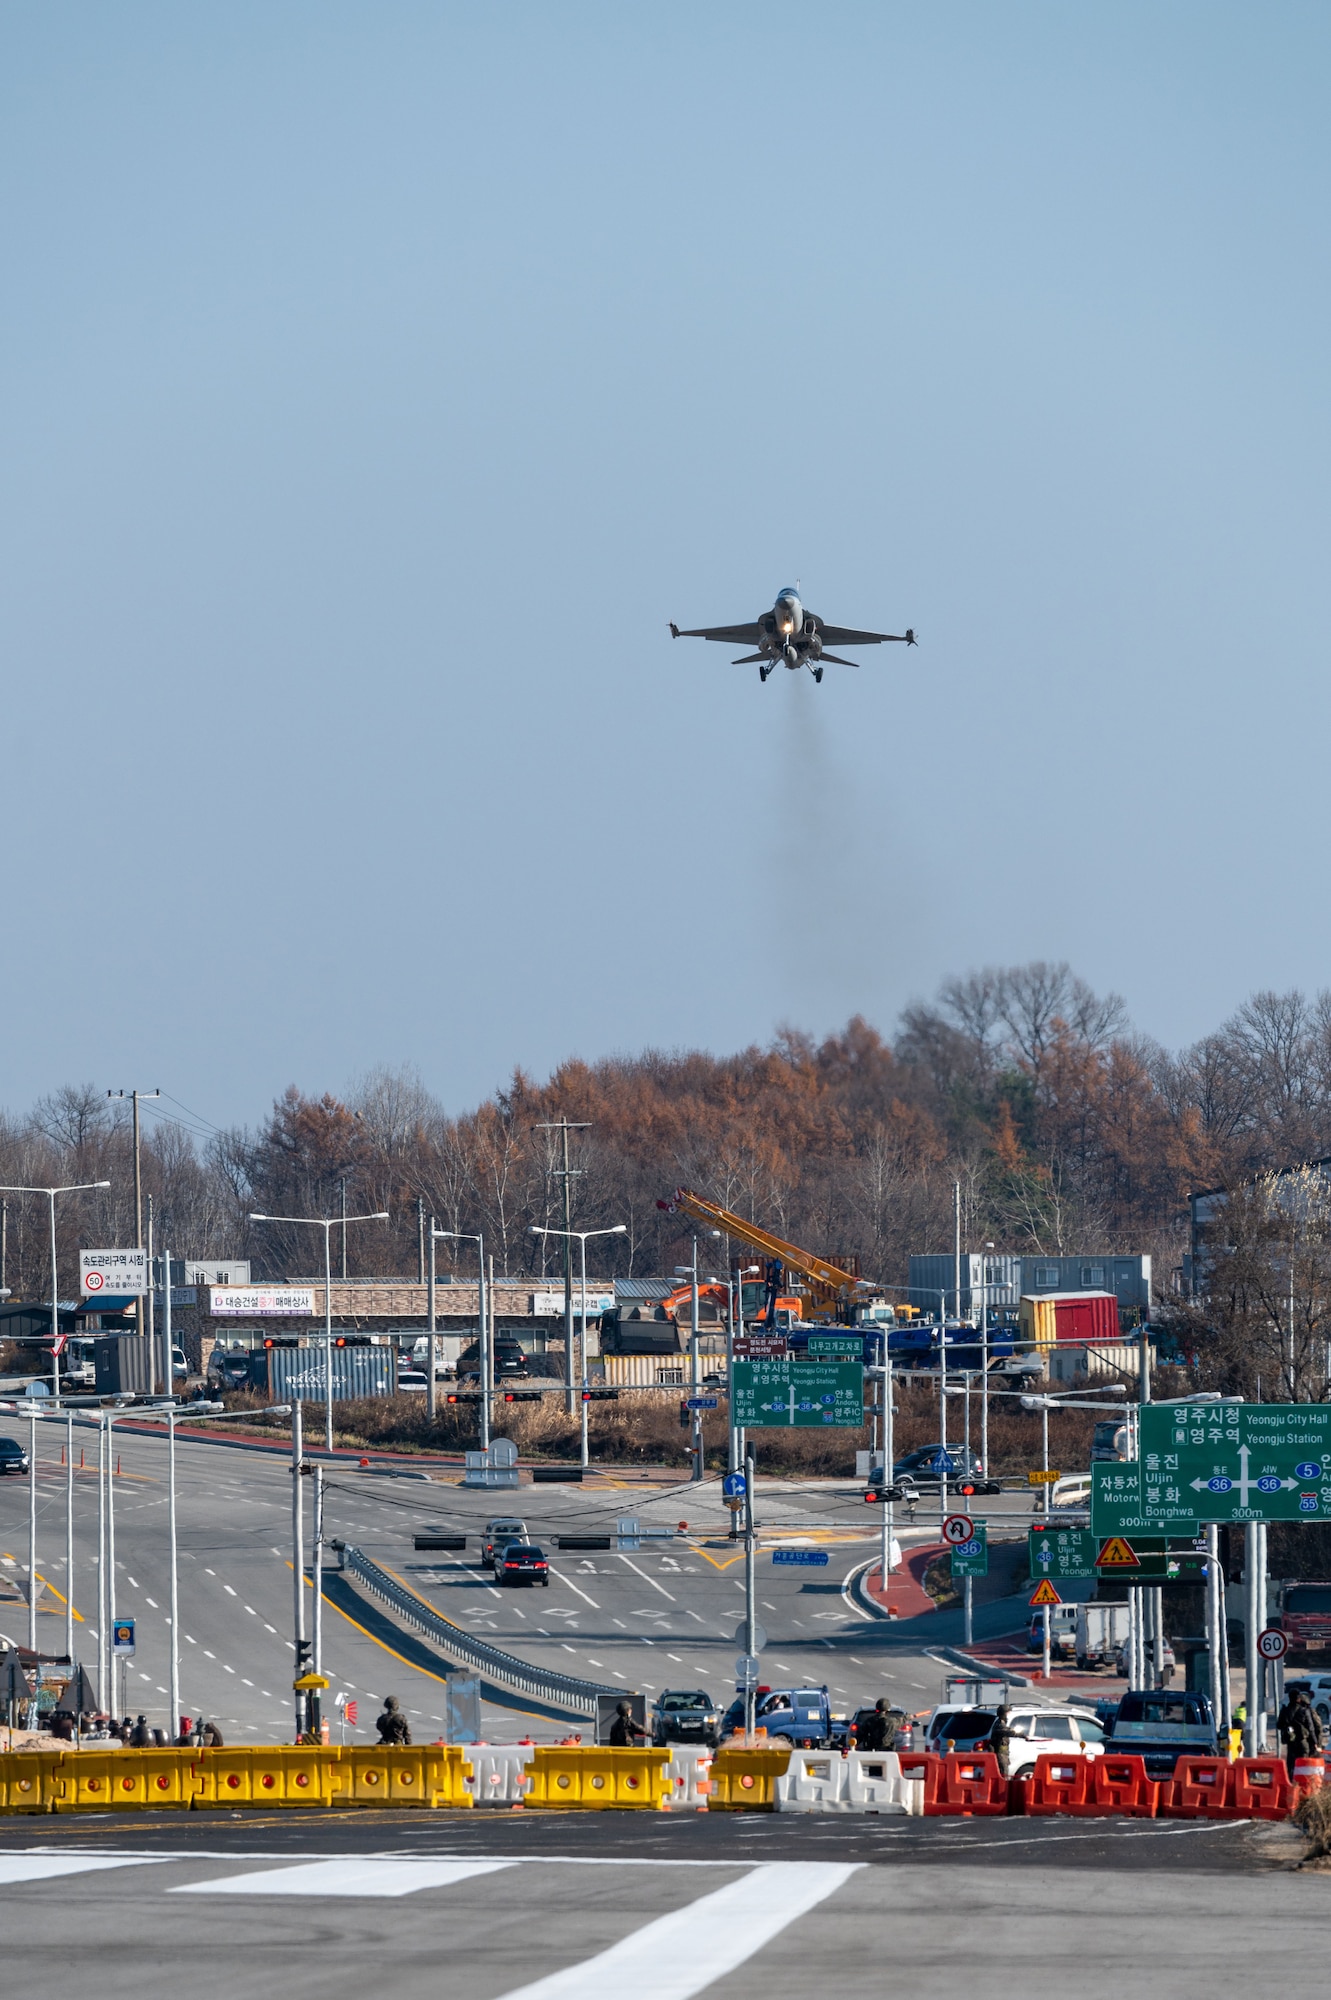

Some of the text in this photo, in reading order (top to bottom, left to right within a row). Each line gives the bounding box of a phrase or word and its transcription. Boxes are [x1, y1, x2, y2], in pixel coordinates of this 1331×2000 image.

[83, 1255, 143, 1266] 속도관리구역 시점
[89, 1277, 99, 1285] 50
[225, 1296, 309, 1308] 대승건설중기매매상사
[810, 1342, 860, 1351] 나무고개교차로
[752, 1363, 790, 1373] 영주시청
[793, 1367, 815, 1375] Yeongju
[816, 1366, 828, 1375] City
[761, 1375, 790, 1384] 영주역
[793, 1378, 815, 1386] Yeongju
[736, 1389, 755, 1399] 울진
[835, 1390, 854, 1399] 안동
[835, 1400, 859, 1408] Andong
[736, 1408, 756, 1417] 봉화
[834, 1408, 860, 1416] 영주IC
[1174, 1407, 1239, 1424] 영주시청
[1246, 1413, 1328, 1427] Yeongju City Hall
[1190, 1428, 1239, 1444] 영주역
[1246, 1433, 1323, 1446] Yeongju Station
[1145, 1453, 1179, 1470] 울진
[1303, 1464, 1313, 1477] 5
[1145, 1473, 1173, 1485] Uljin
[1212, 1479, 1228, 1490] 36
[1261, 1480, 1277, 1490] 36
[1145, 1487, 1181, 1503] 봉화
[1302, 1498, 1316, 1509] 55
[1145, 1506, 1194, 1518] Bonghwa
[1232, 1508, 1263, 1518] 300m
[1057, 1534, 1082, 1545] 울진
[961, 1542, 978, 1554] 36
[1058, 1546, 1075, 1554] Uljin
[1059, 1555, 1083, 1567] 영주
[1060, 1568, 1092, 1577] Yeongju
[1263, 1637, 1281, 1652] 60
